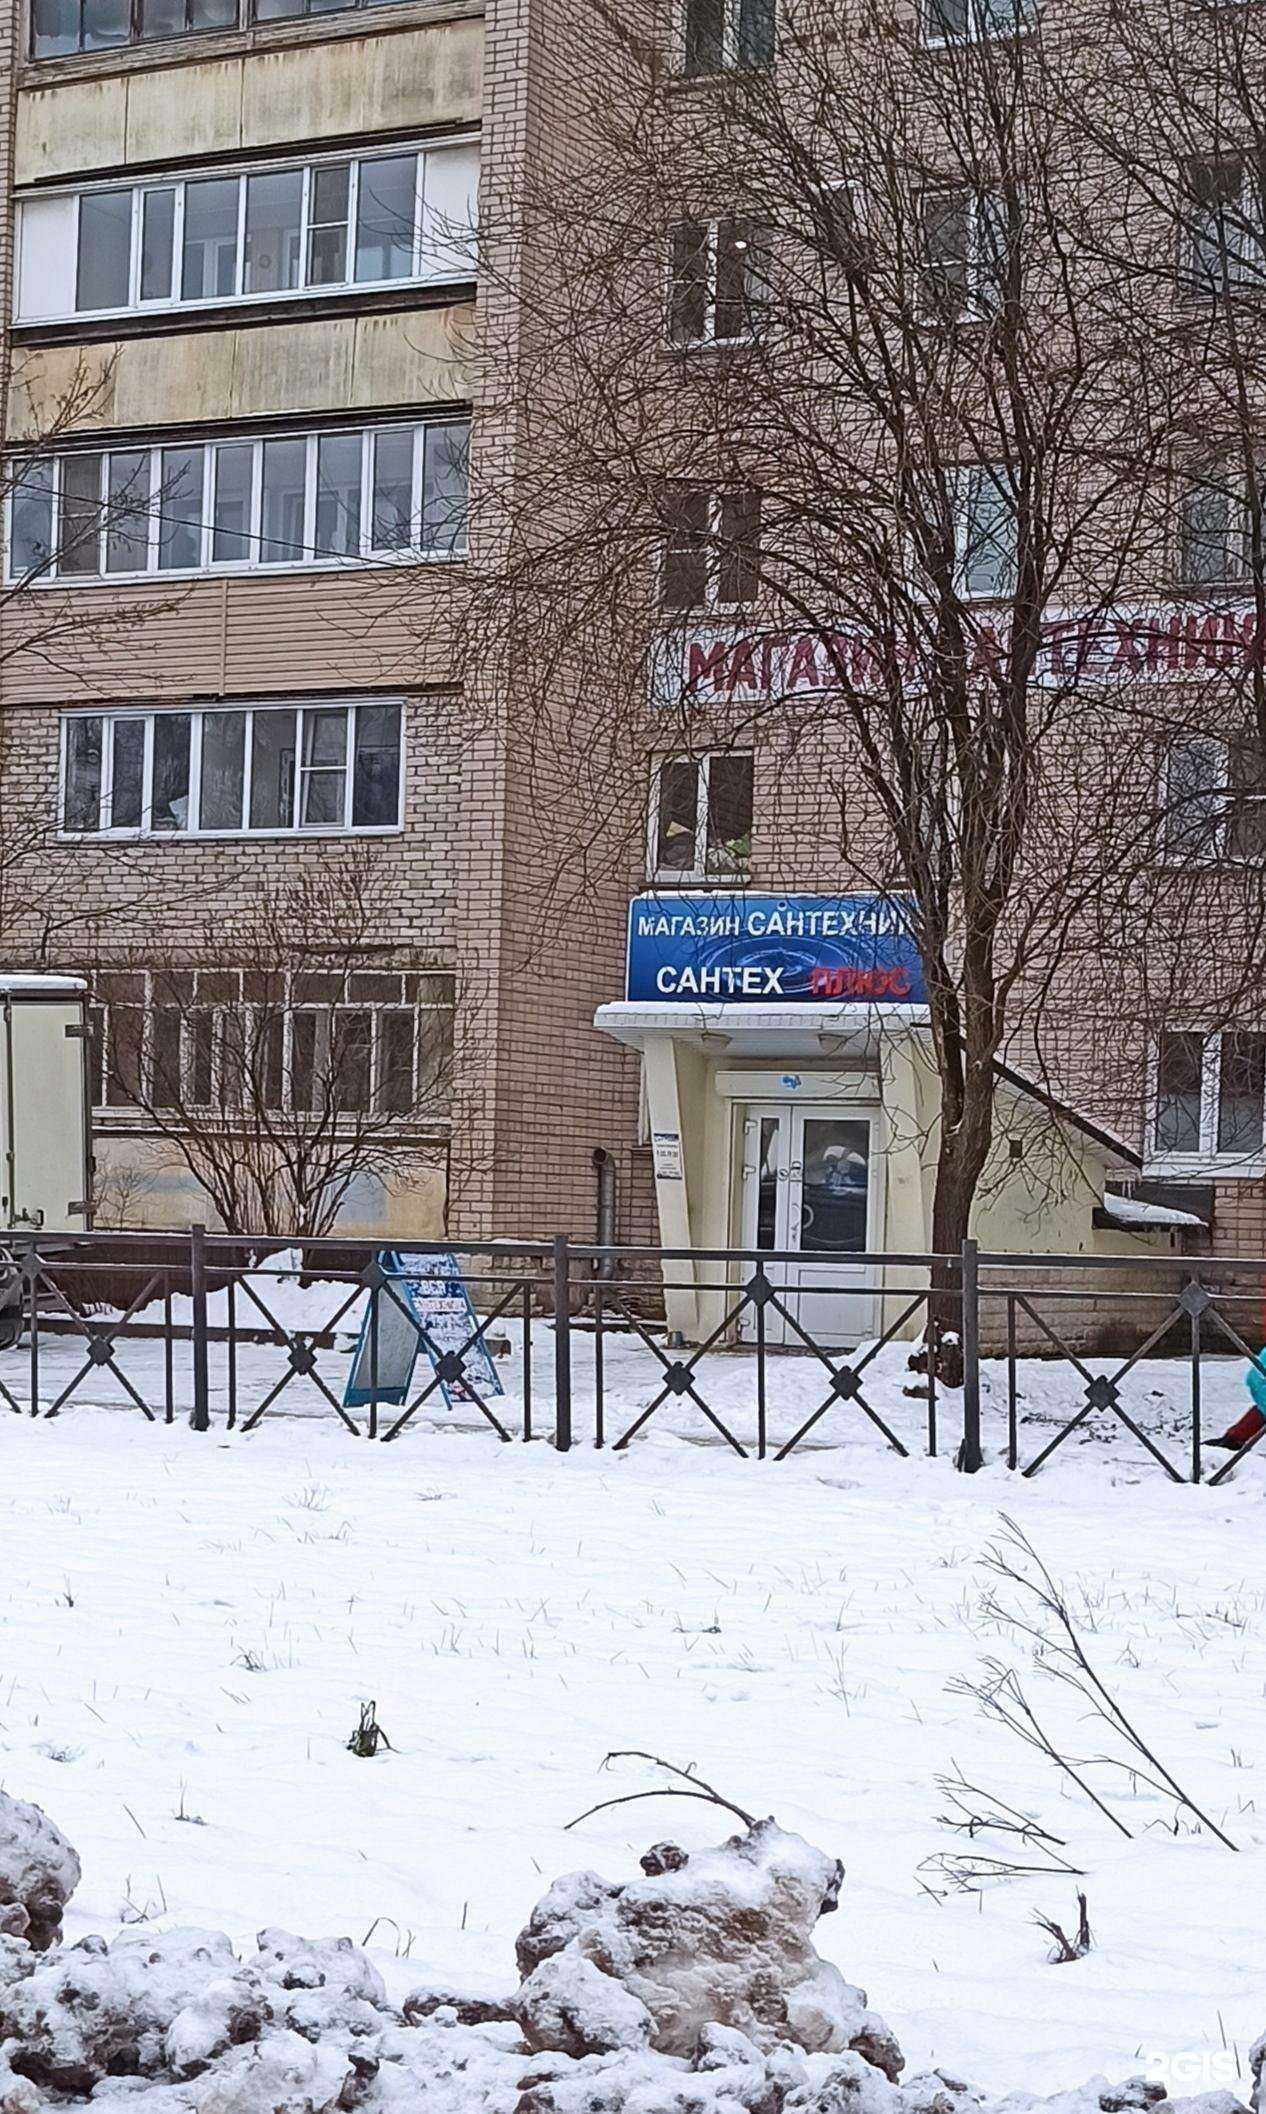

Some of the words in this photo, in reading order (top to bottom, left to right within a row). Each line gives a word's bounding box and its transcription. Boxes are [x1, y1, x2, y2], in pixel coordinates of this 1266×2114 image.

[637, 915, 740, 937] МАГАЗИН
[656, 965, 785, 995] САНТЕХ
[809, 966, 911, 997] ПЛЮС
